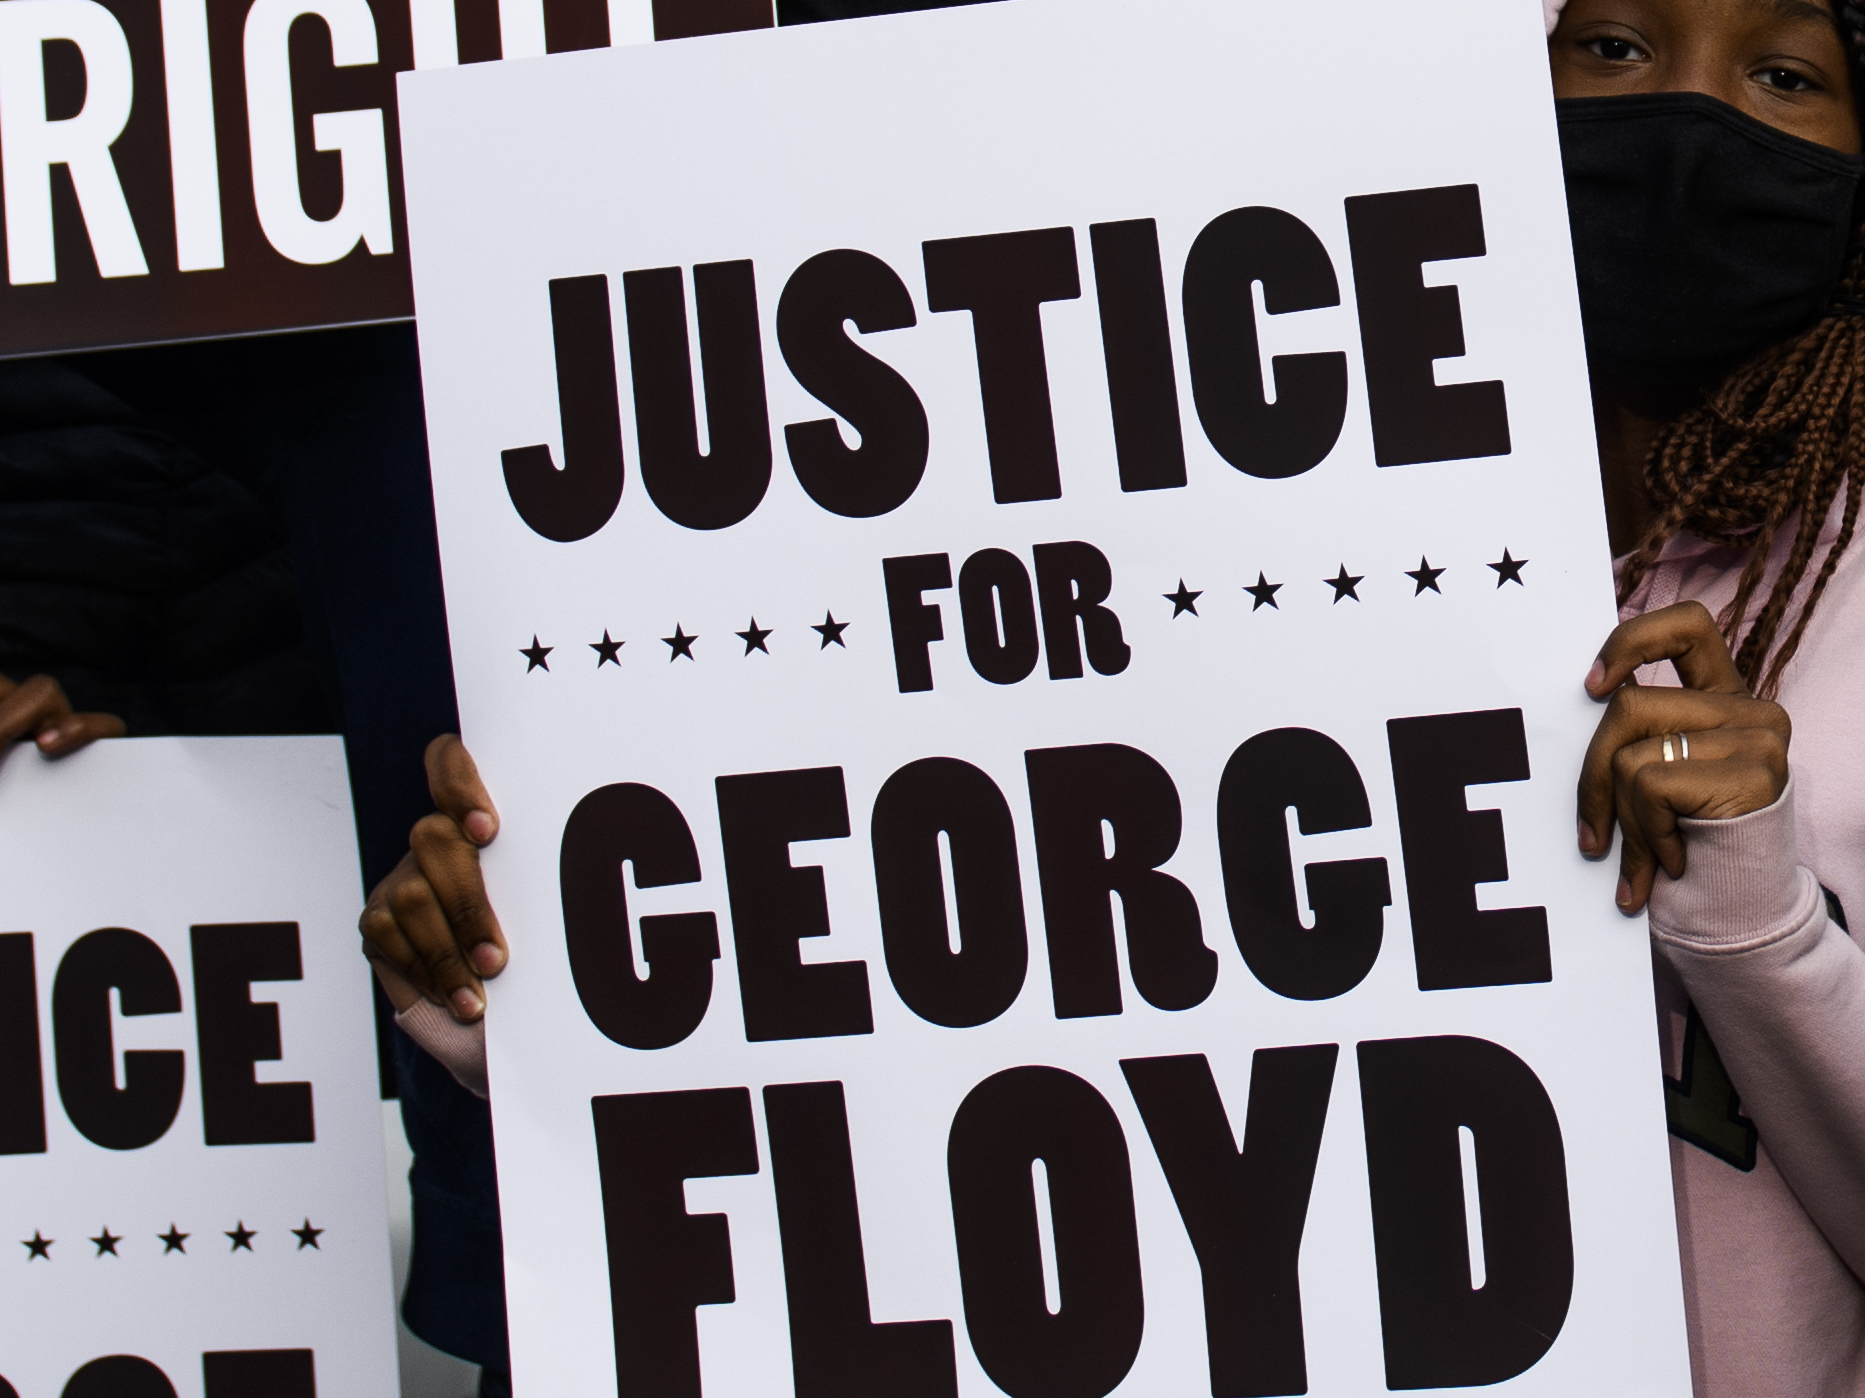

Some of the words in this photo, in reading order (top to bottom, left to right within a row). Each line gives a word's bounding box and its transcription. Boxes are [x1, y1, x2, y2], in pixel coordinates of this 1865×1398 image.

[501, 184, 1511, 543] JUSTICE
[882, 541, 1131, 693] FOR
[560, 708, 1552, 1050] GEORGE
